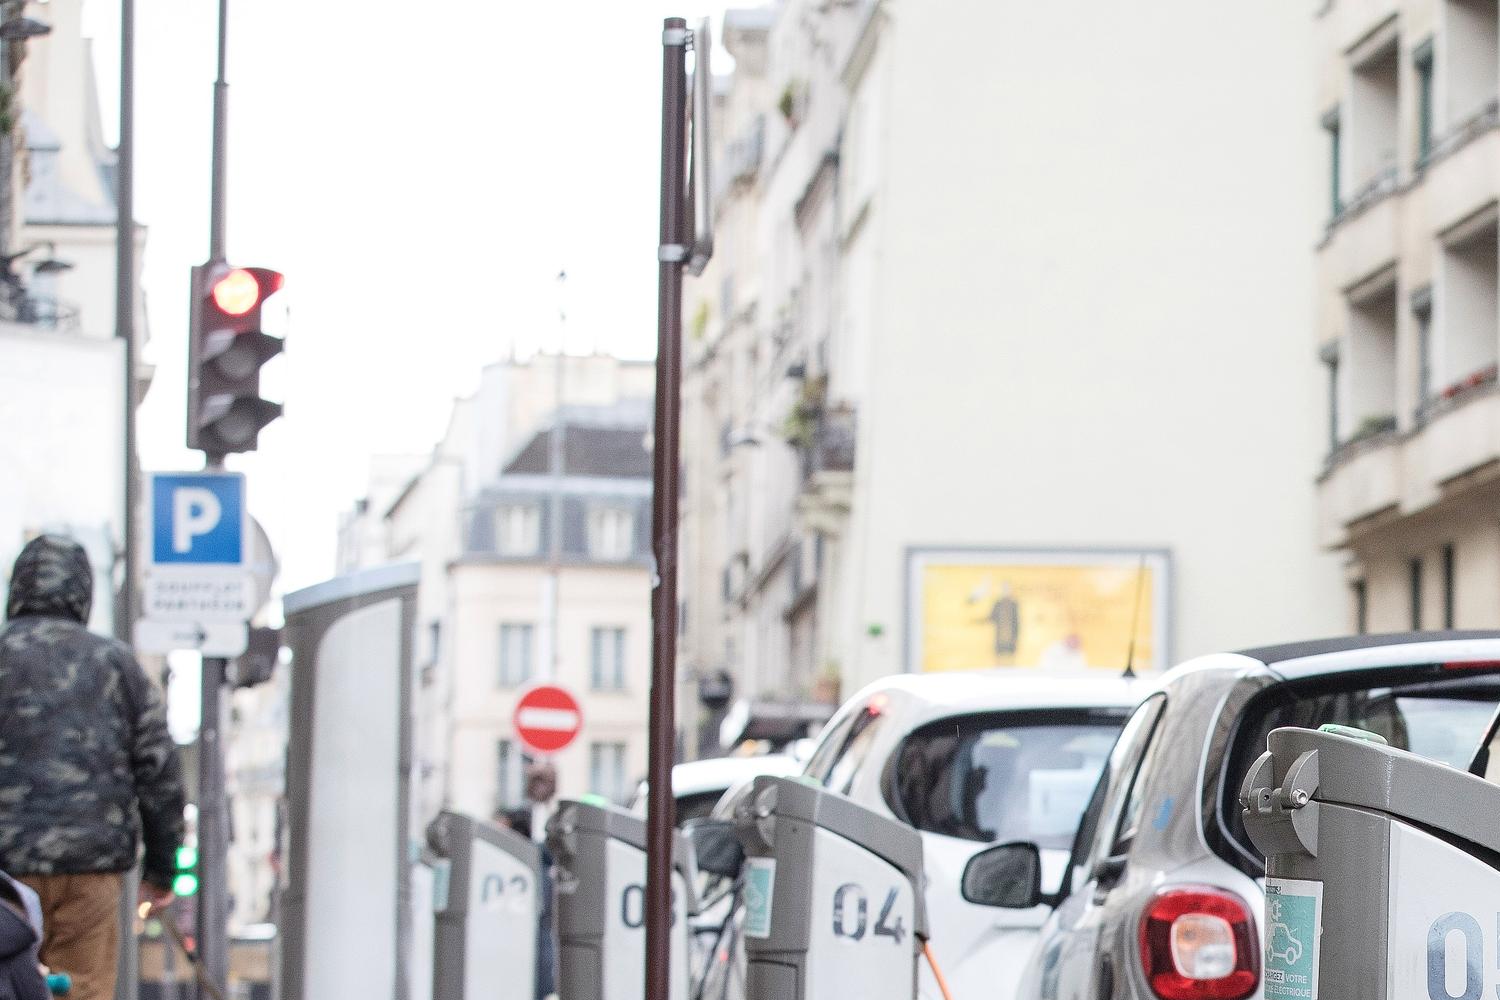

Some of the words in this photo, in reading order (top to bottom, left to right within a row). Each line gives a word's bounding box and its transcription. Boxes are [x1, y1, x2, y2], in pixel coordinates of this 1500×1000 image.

[172, 486, 221, 553] P
[833, 883, 905, 944] 04
[1285, 973, 1308, 984] VOTRE
